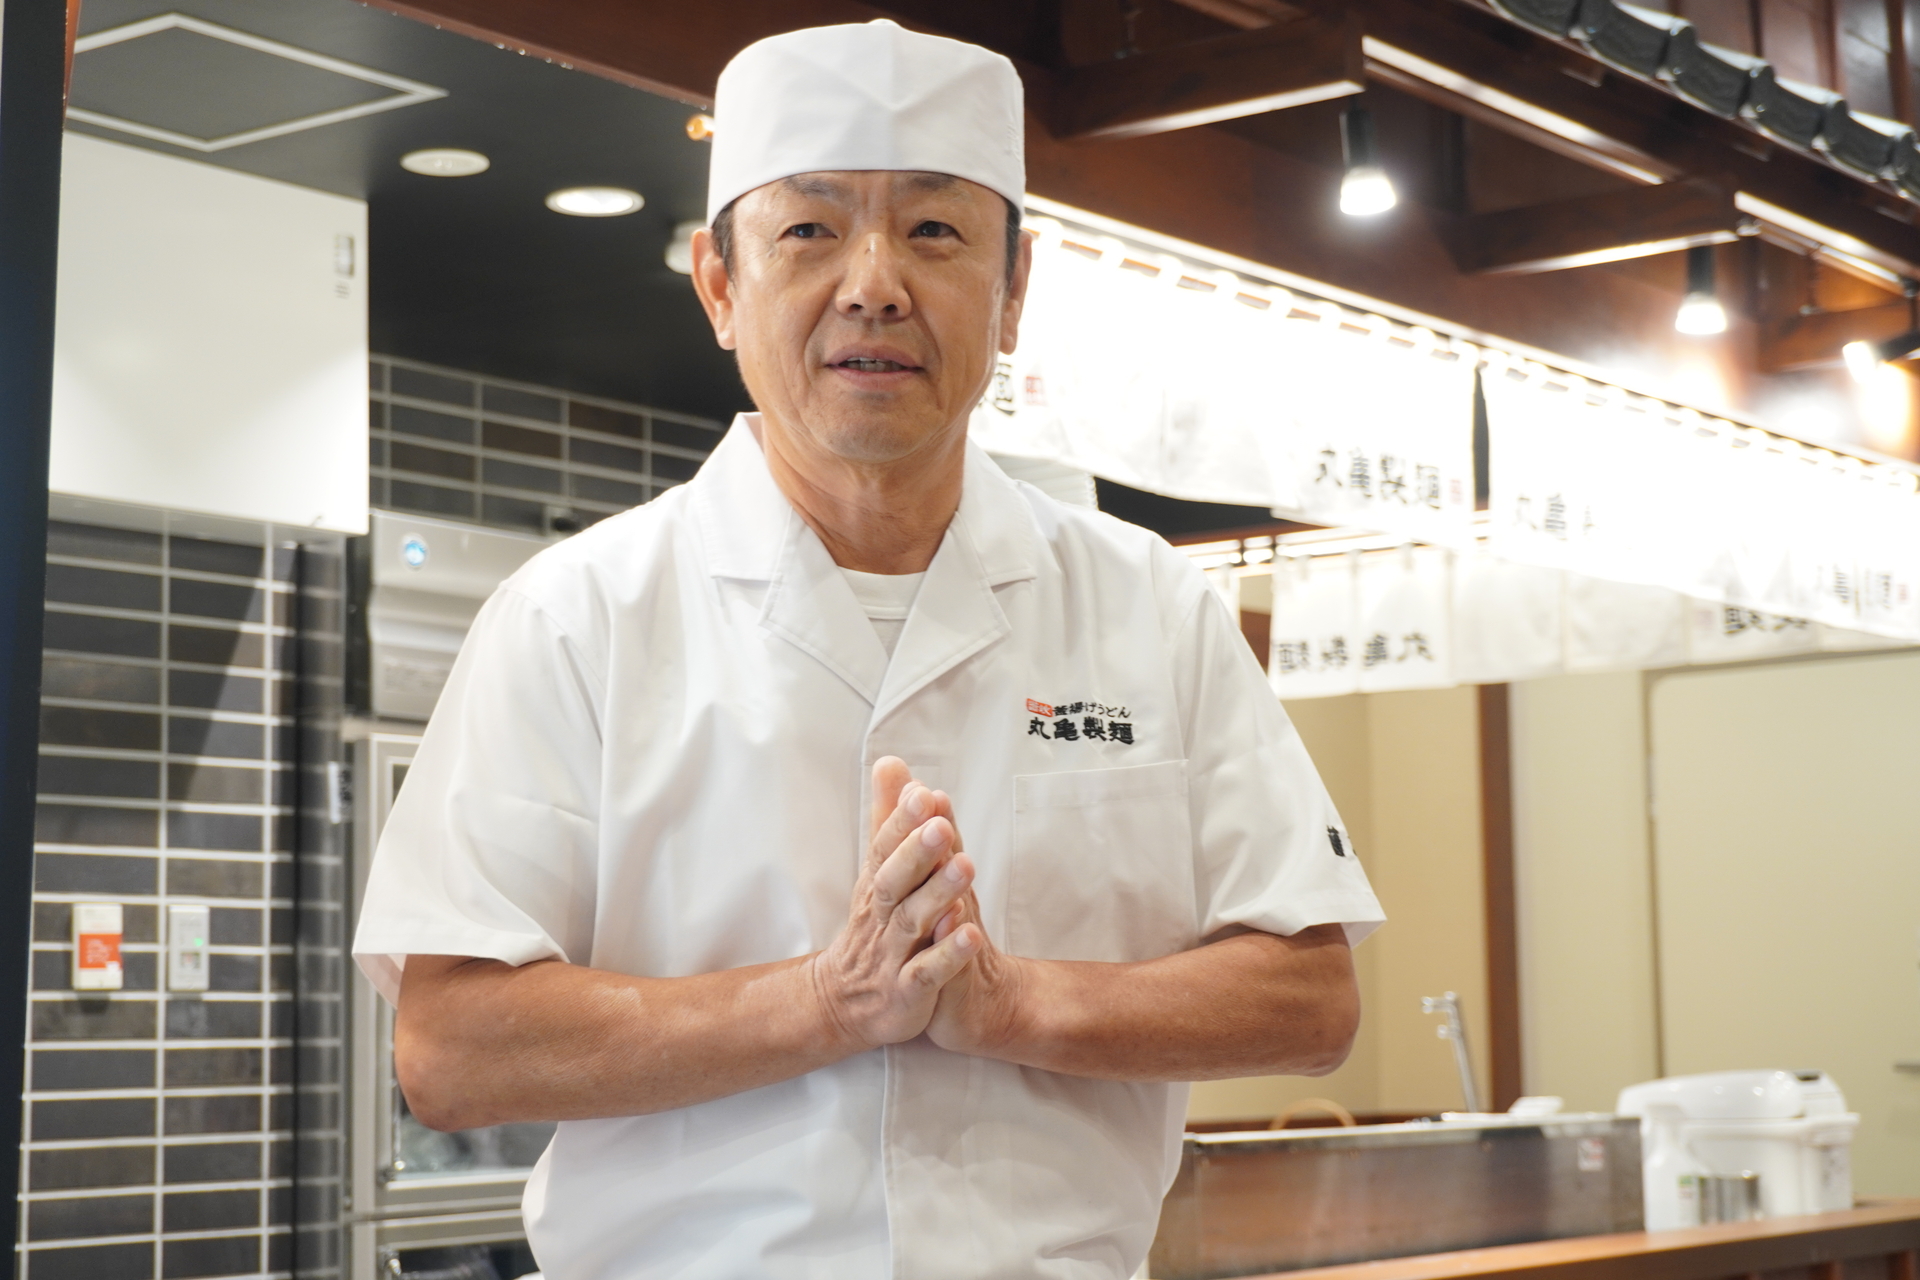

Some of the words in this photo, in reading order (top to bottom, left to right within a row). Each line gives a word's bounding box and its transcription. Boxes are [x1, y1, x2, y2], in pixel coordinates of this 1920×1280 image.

[1053, 701, 1131, 718] 釜揚げうどん
[1027, 716, 1135, 745] 丸亀製麺
